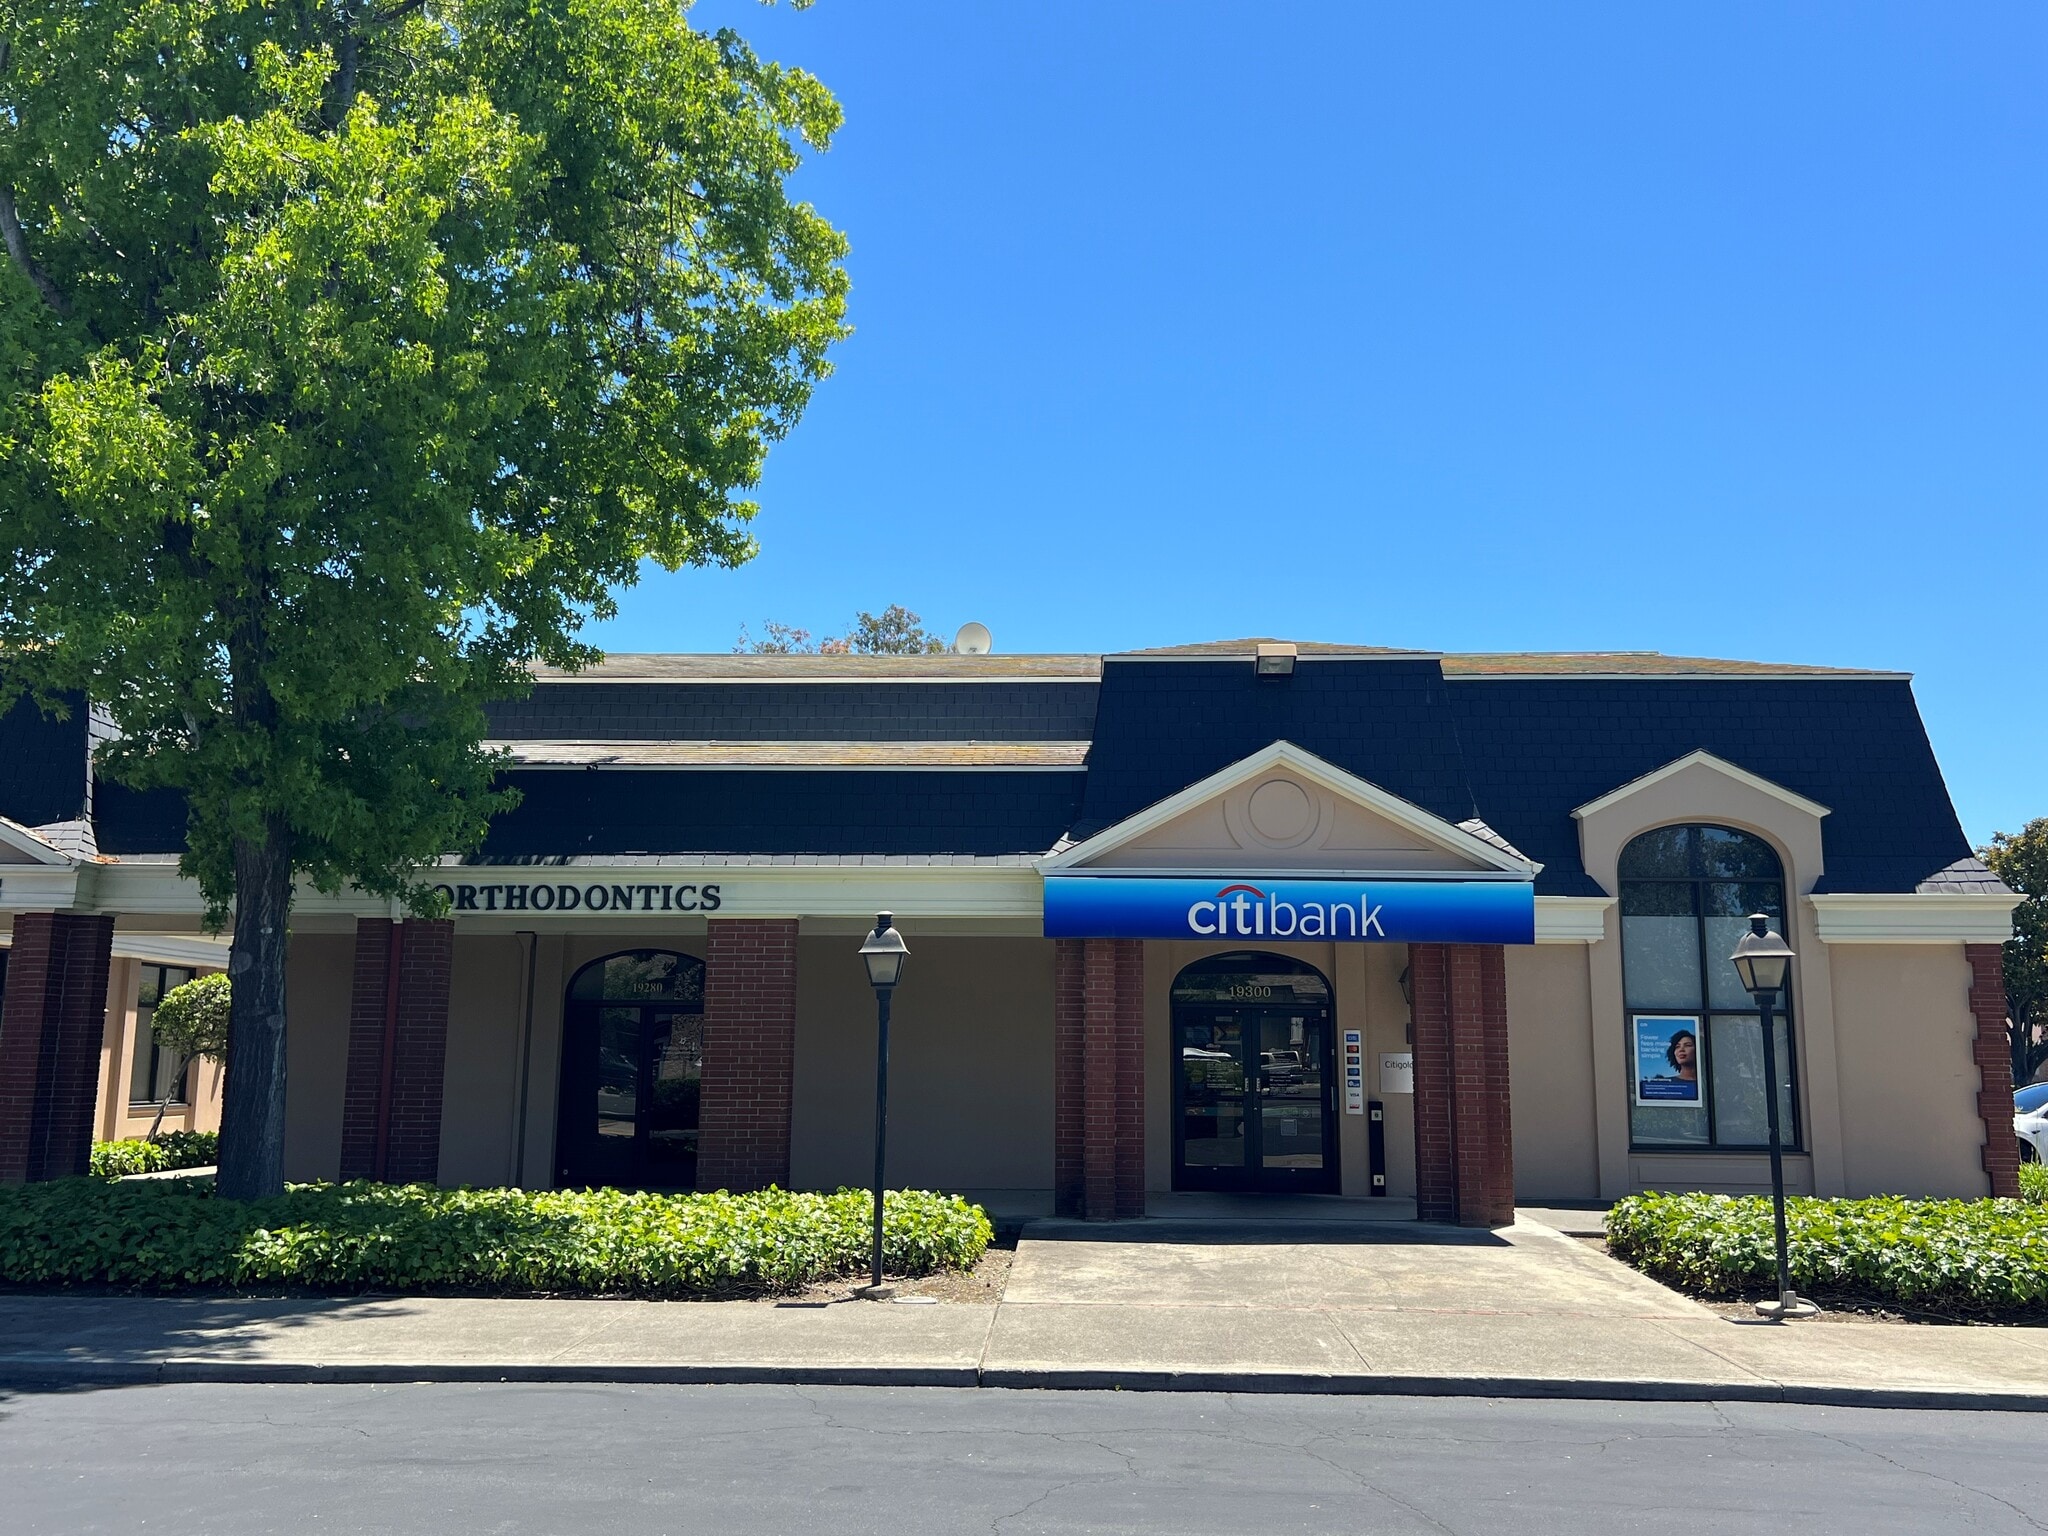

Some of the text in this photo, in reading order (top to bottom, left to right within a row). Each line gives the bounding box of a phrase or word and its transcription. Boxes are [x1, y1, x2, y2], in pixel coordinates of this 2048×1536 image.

[1187, 891, 1386, 937] citibank
[633, 983, 663, 993] 19280
[1229, 986, 1271, 998] 19300
